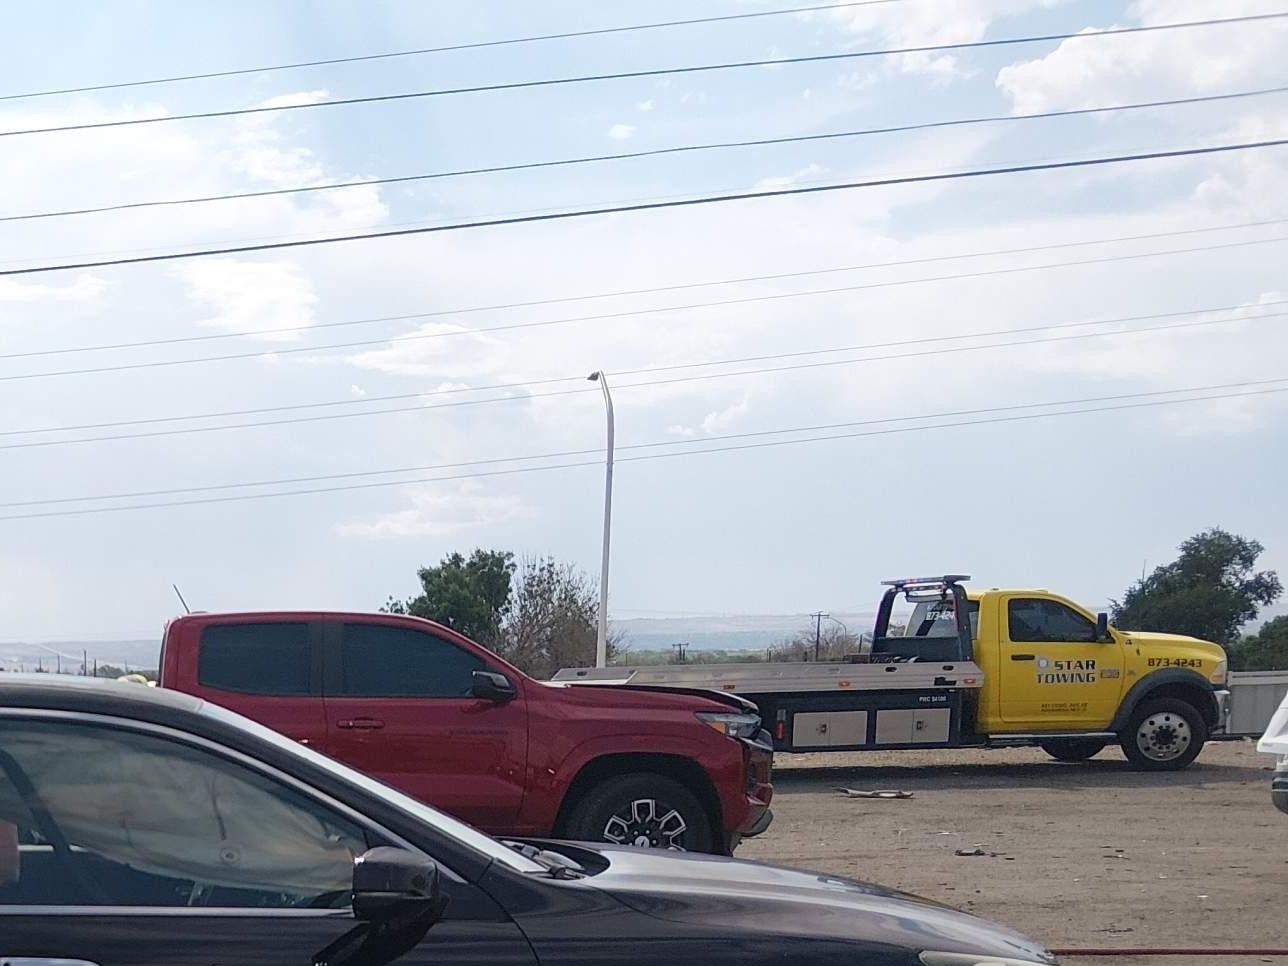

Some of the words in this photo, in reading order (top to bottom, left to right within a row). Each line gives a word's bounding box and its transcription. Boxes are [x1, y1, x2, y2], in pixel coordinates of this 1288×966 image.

[1054, 660, 1096, 671] STAR
[1147, 658, 1202, 667] 873-4243
[1037, 673, 1096, 684] TOWING
